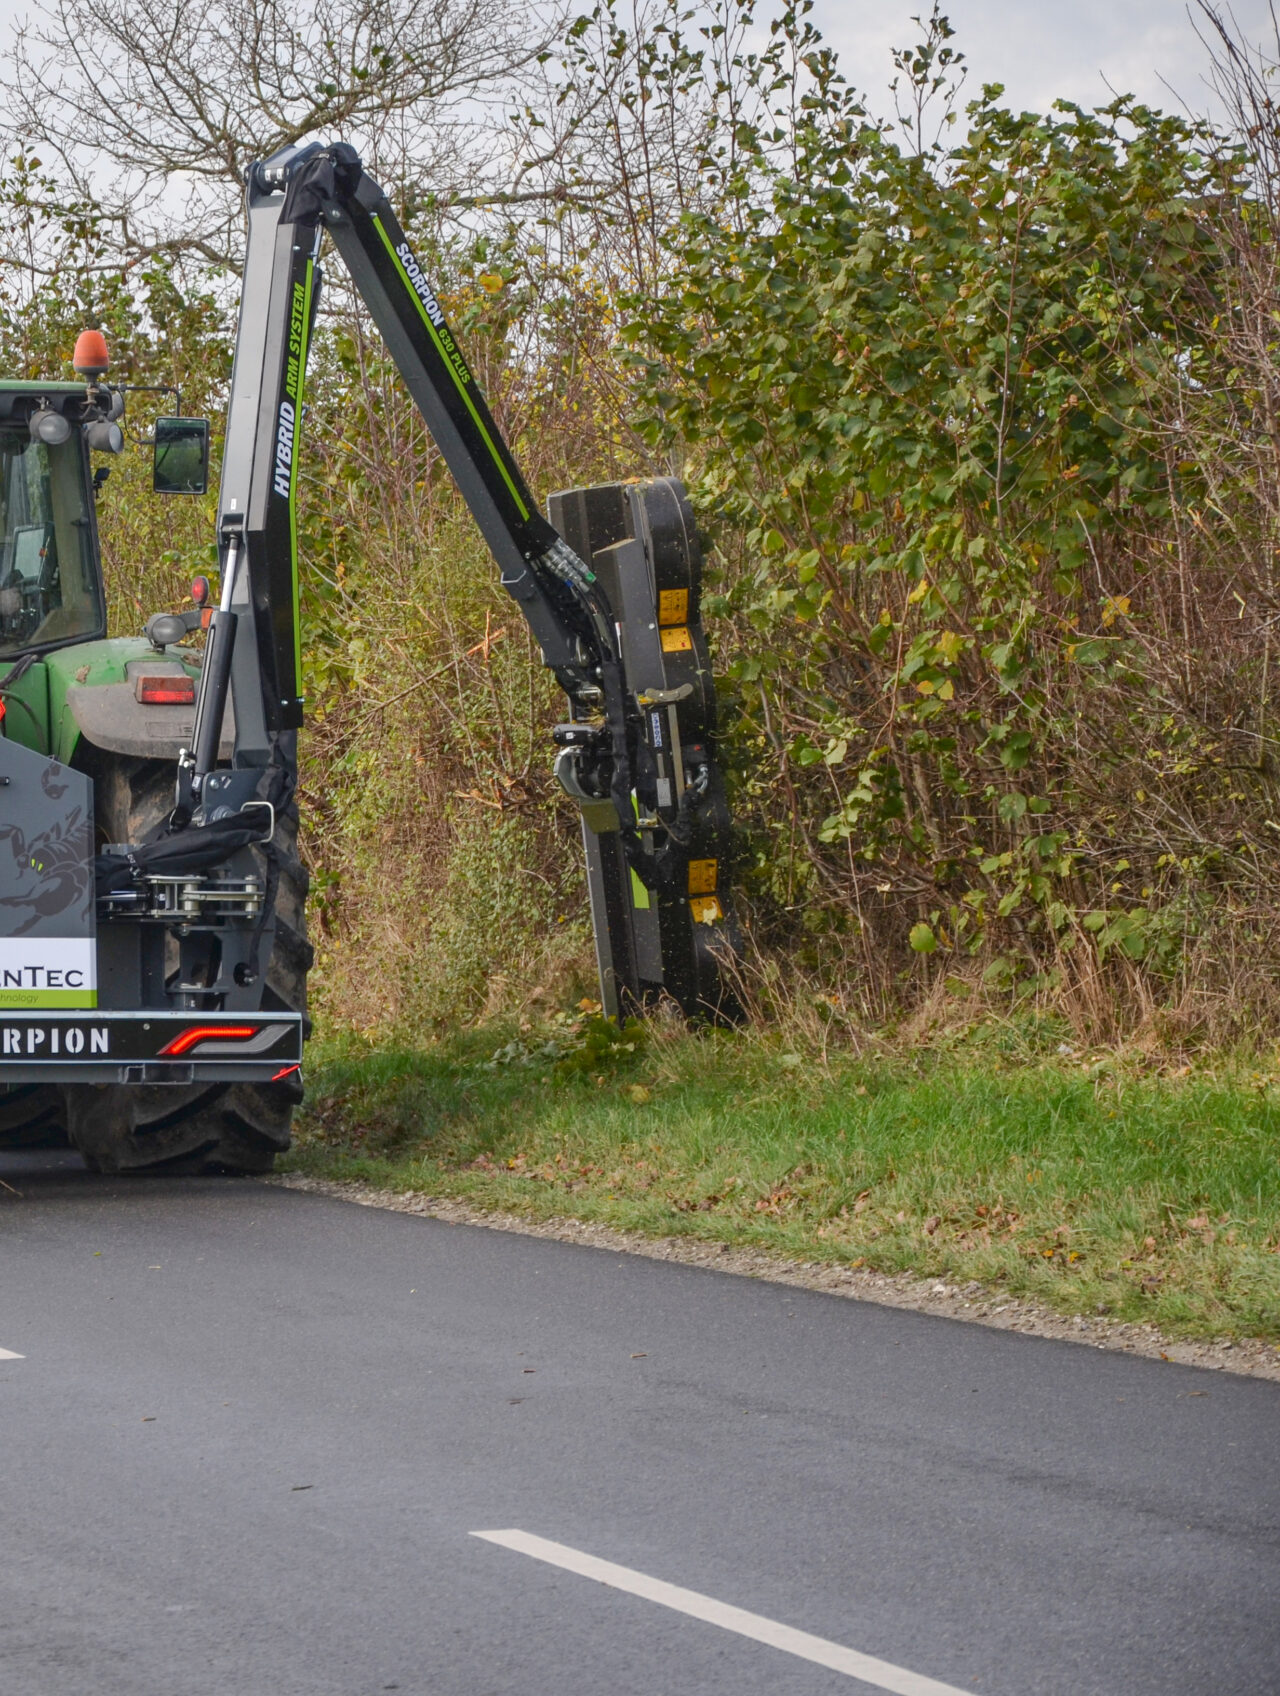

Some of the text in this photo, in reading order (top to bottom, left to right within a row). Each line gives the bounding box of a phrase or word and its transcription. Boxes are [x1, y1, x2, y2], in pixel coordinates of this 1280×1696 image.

[274, 282, 306, 499] HYBRID ARM SYSTEM
[396, 242, 471, 384] SCORPION 630 PLUS
